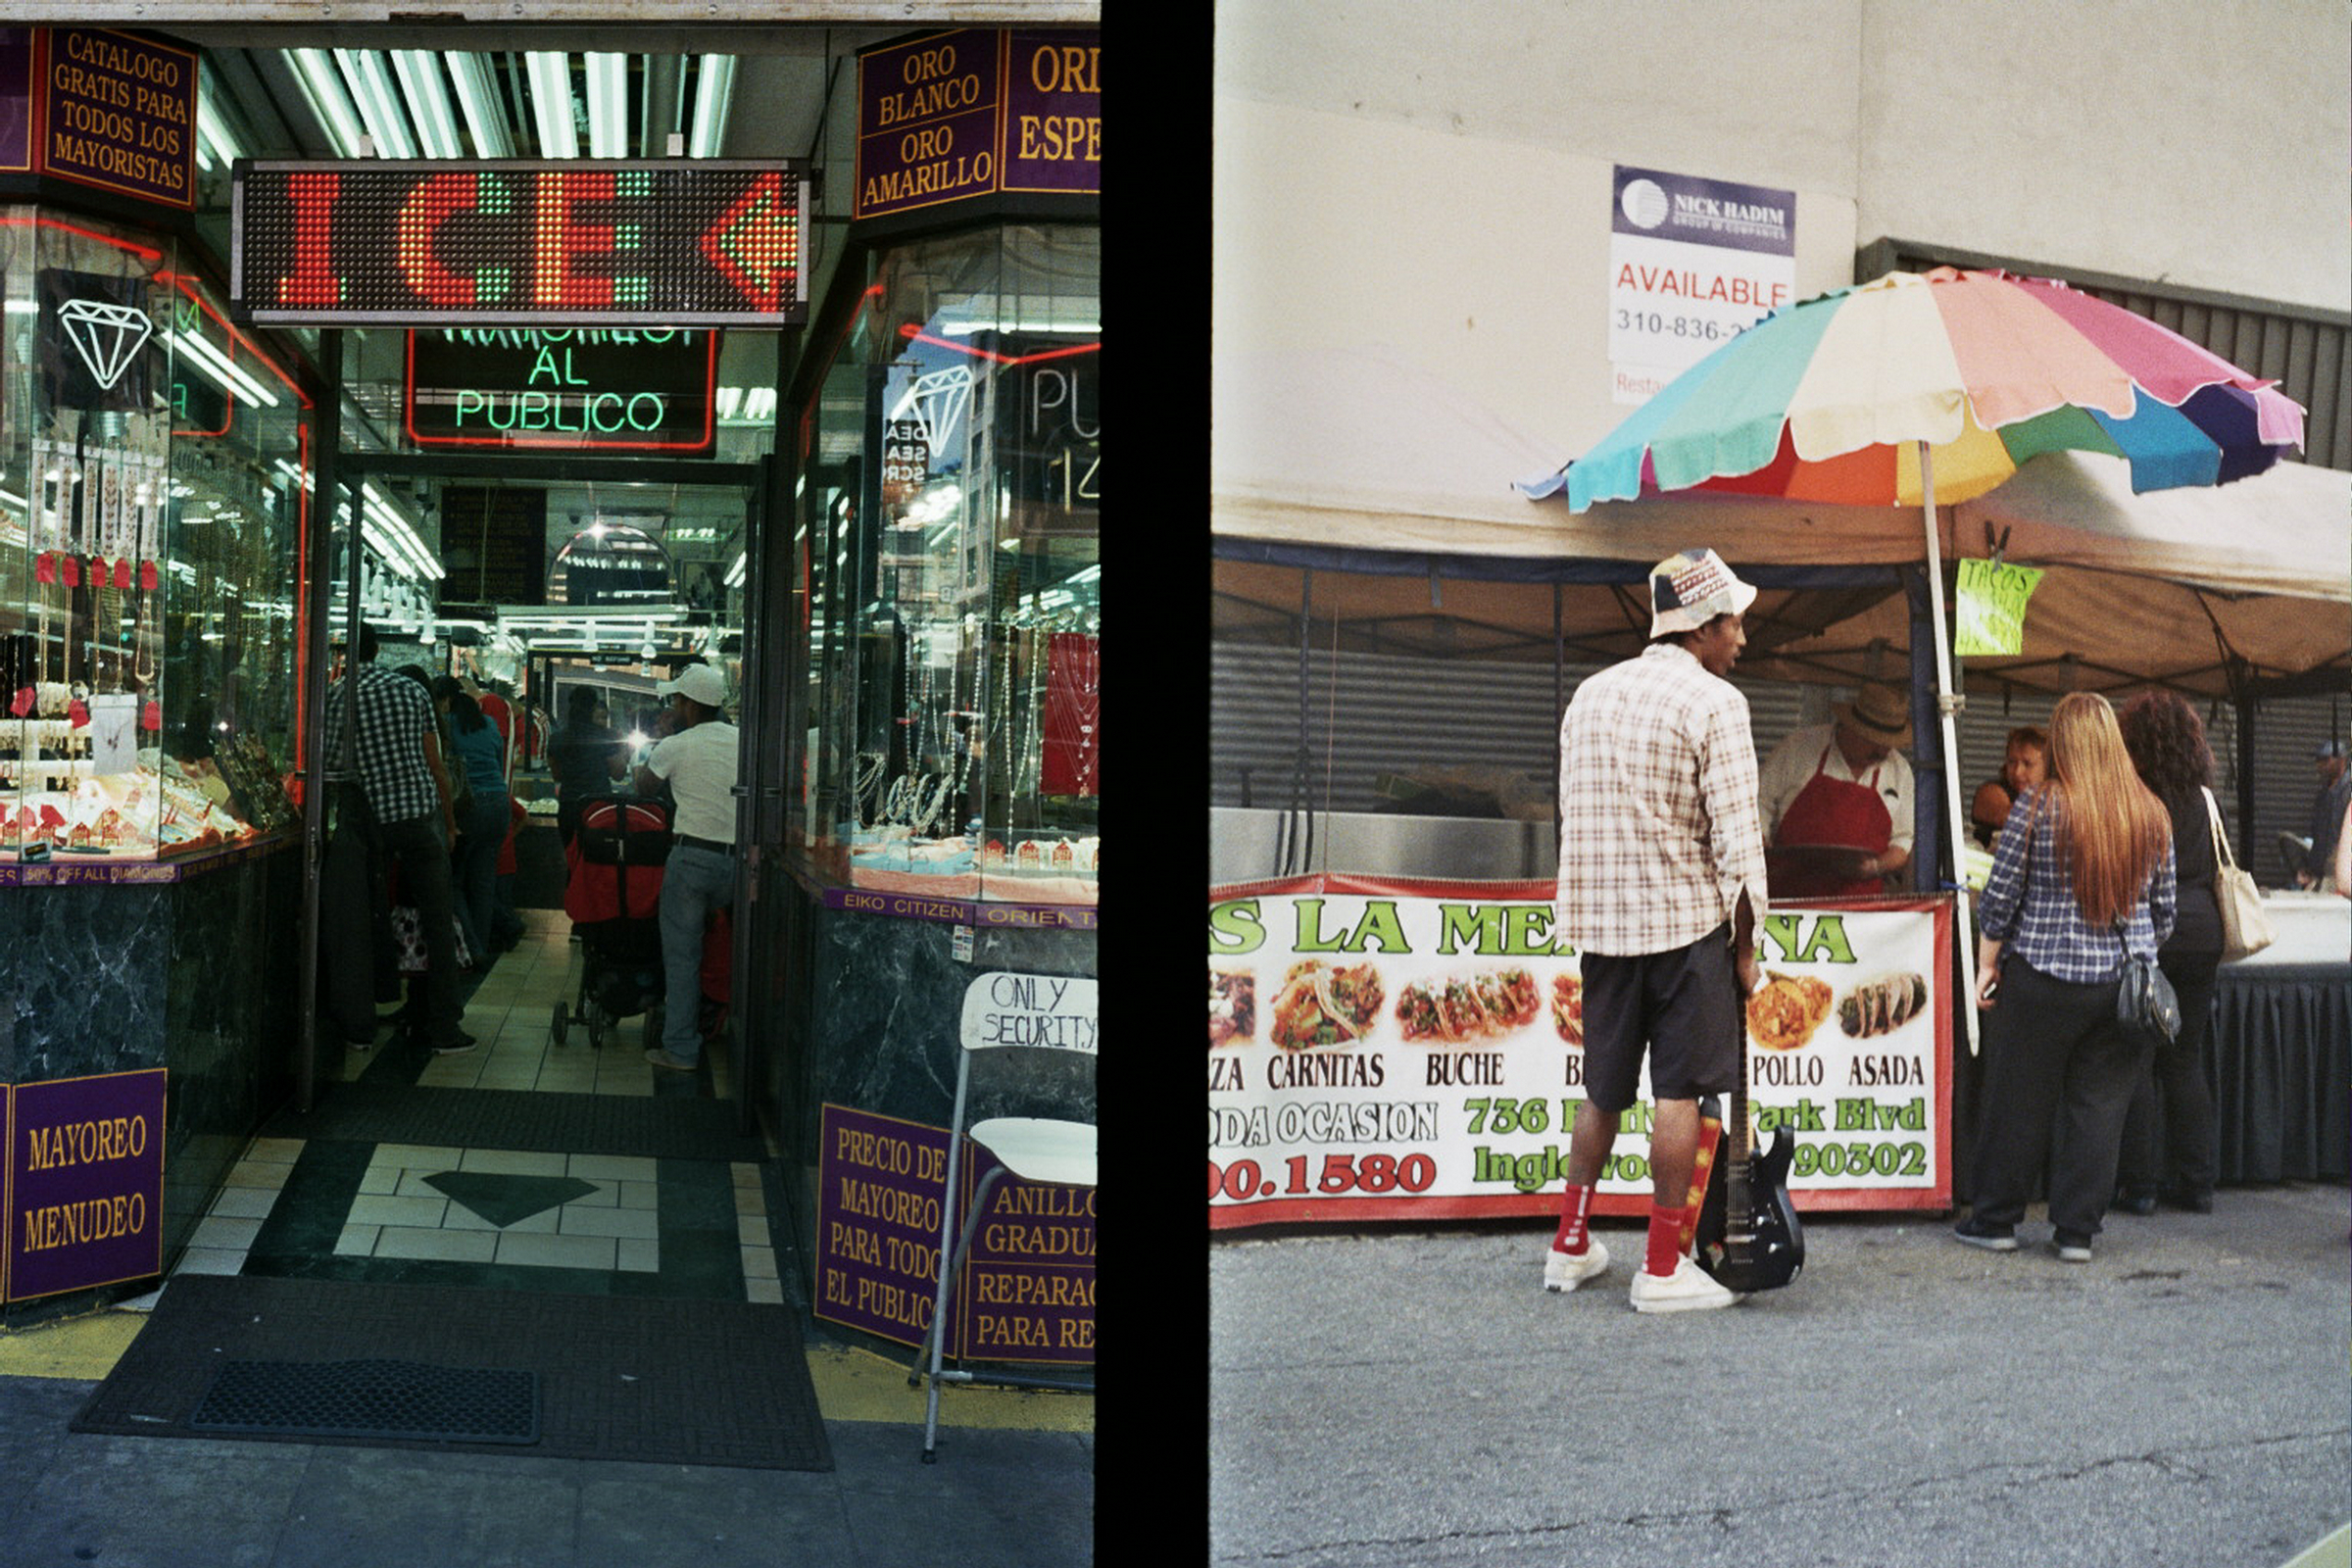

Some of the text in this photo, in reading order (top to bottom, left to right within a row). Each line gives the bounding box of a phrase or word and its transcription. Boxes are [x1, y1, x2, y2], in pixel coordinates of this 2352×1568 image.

[68, 32, 178, 88] CATALOGO
[904, 45, 956, 85] ORO
[55, 64, 187, 124] GRATIS PARA
[878, 74, 980, 126] BLANCO
[62, 100, 180, 155] TODOS LOS
[901, 124, 954, 164] ORO
[1018, 115, 1102, 161] ESPE
[55, 133, 184, 190] MAYORISTAS
[861, 151, 992, 208] AMARILLO
[1674, 193, 1721, 218] NICK
[1617, 263, 1788, 308] AVAILABLE
[1617, 309, 1754, 341] 310-836-2
[528, 345, 589, 385] AL
[456, 390, 664, 432] PUBLICO
[84, 866, 107, 880] ALL
[895, 899, 964, 919] CITIZEN
[987, 908, 1098, 927] ORIENT
[1293, 899, 1413, 955] LA
[992, 974, 1068, 1012] ONLY
[982, 1013, 1098, 1050] SECURITY
[1266, 1052, 1385, 1089] CARNITAS
[1425, 1052, 1505, 1086] BUCHE
[1752, 1055, 1825, 1087] POLLO
[1847, 1054, 1926, 1087] ASADA
[1276, 1101, 1439, 1145] OCASION
[1463, 1098, 1550, 1134] 736
[1834, 1097, 1928, 1132] Blvd
[27, 1114, 147, 1172] MAYOREO
[836, 1127, 947, 1185] PRECIO DE
[1792, 1141, 1928, 1178] 90302
[24, 1192, 146, 1253] MENUDEO
[839, 1176, 940, 1234] MAYOREO
[830, 1221, 883, 1267] PARA
[985, 1223, 1097, 1256] GRADU
[826, 1267, 939, 1332] EL PUBLIC
[976, 1273, 1096, 1307] REPARA
[976, 1314, 1096, 1348] PARA RE
